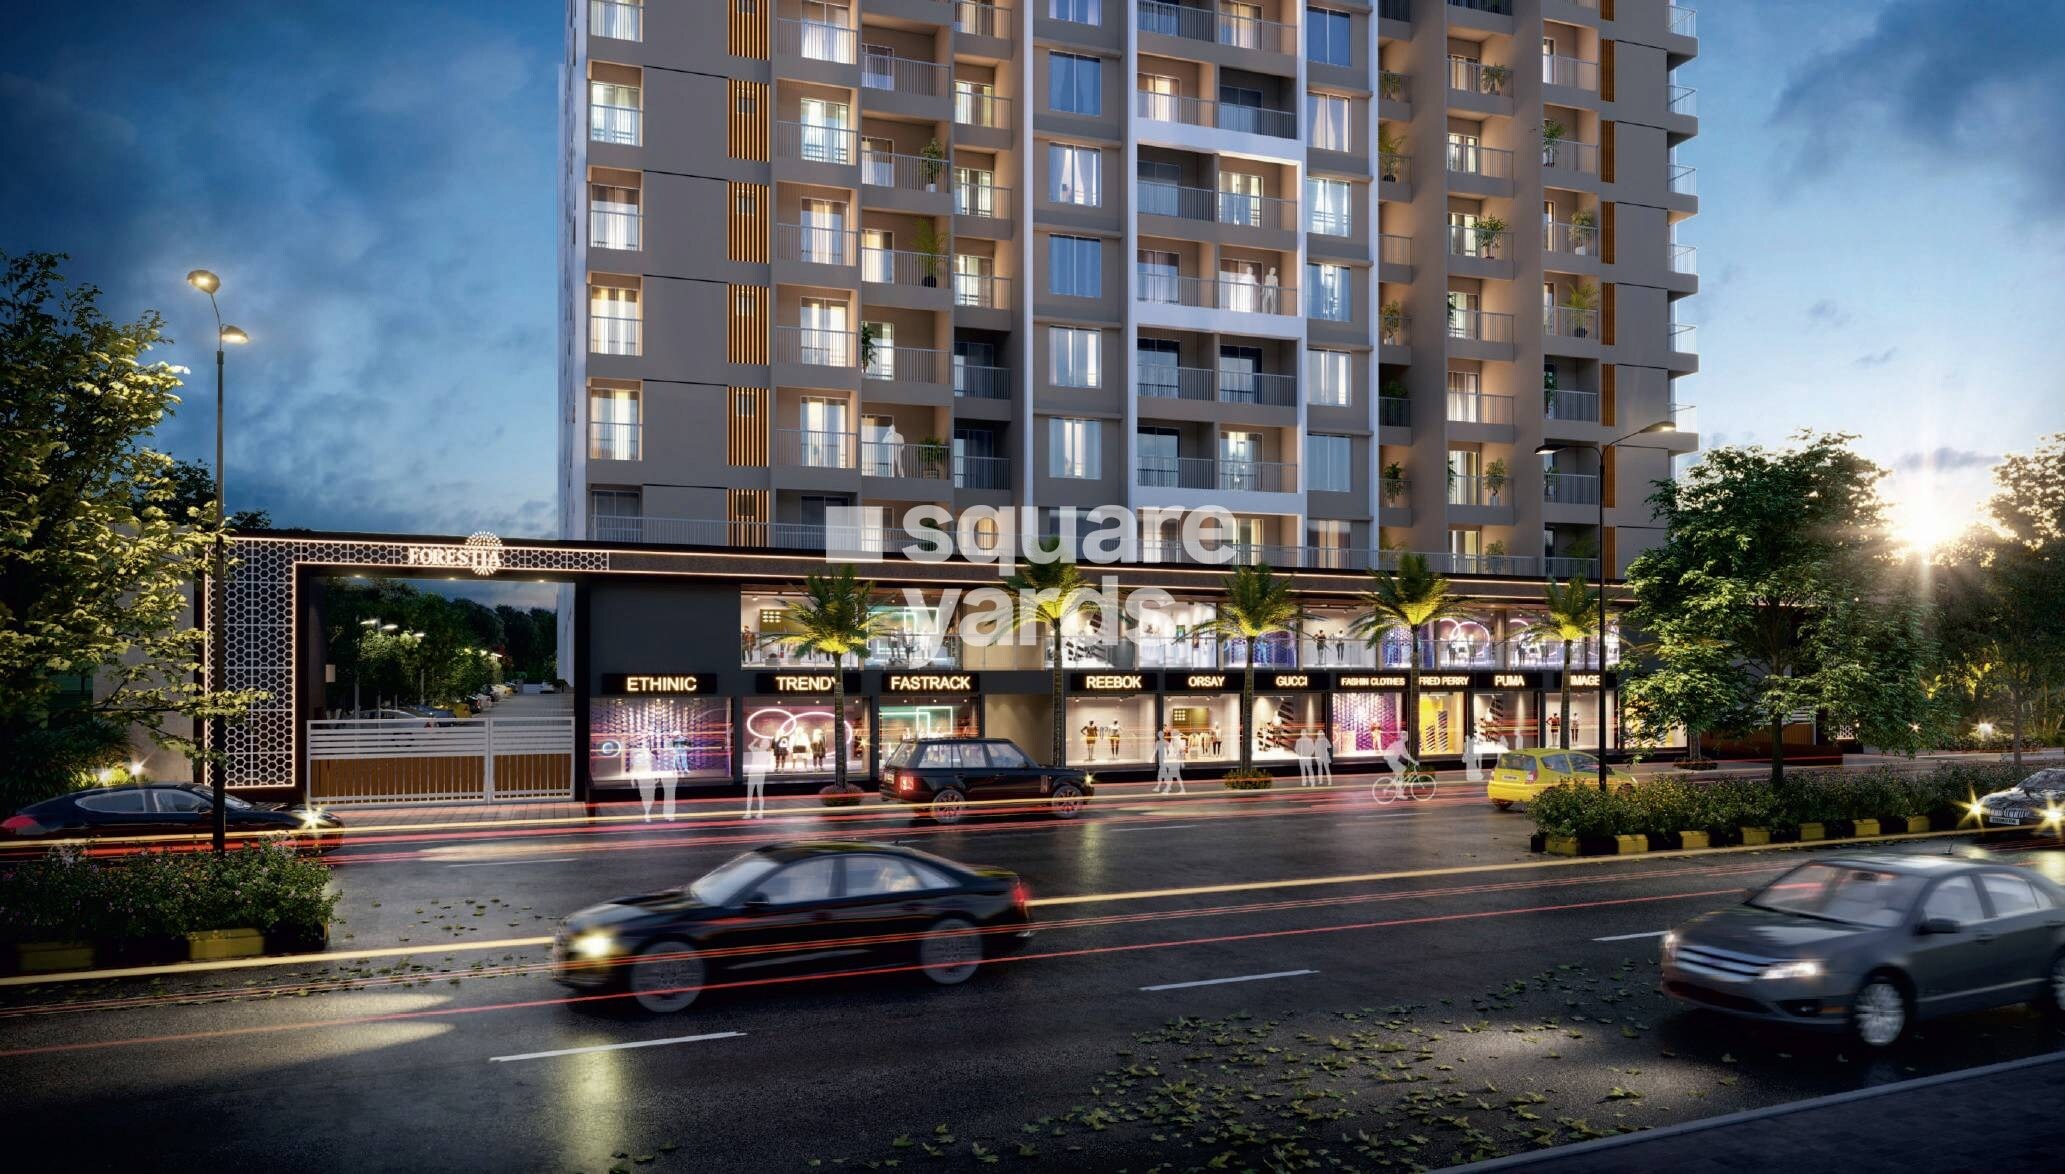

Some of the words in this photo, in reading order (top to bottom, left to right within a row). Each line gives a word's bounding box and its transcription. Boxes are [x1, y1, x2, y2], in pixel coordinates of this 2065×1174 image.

[626, 676, 697, 692] ETHINIC
[890, 675, 971, 691] FASTRACK
[1086, 676, 1142, 689] REEBOK
[1188, 676, 1225, 687] ORSAY
[1276, 676, 1308, 687] GUCCI
[1370, 677, 1405, 686] CLOTHES
[1419, 676, 1440, 686] FRED
[1441, 676, 1469, 686] PERRY
[1495, 675, 1525, 687] PUMA
